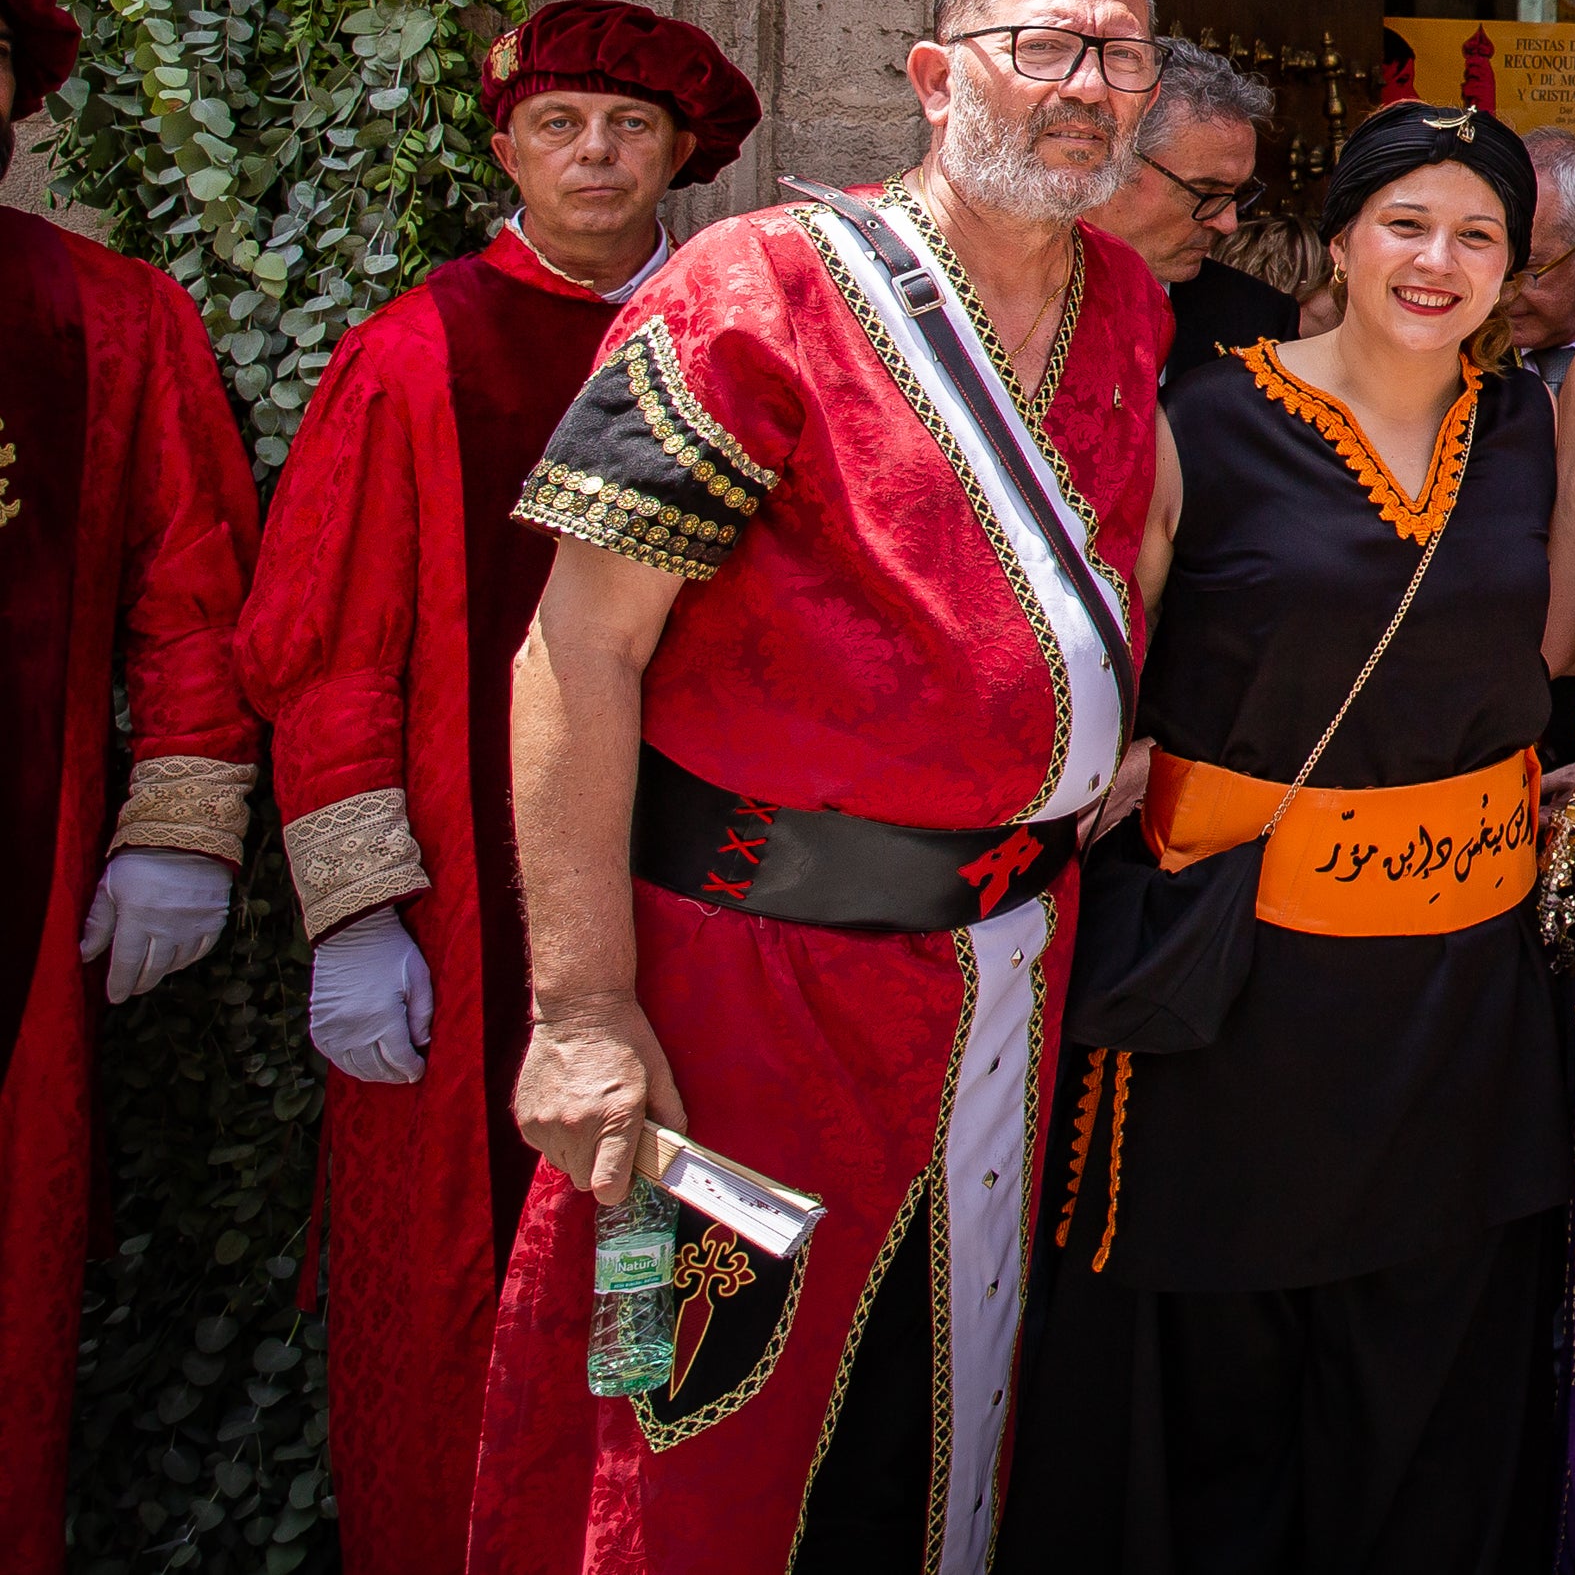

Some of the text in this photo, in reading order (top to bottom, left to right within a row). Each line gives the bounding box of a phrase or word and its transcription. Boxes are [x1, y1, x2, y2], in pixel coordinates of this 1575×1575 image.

[1516, 38, 1565, 52] FIESTAS
[1526, 73, 1536, 85] Y
[1540, 74, 1556, 86] DE
[1517, 88, 1526, 101] Y
[616, 1258, 658, 1274] Natura
